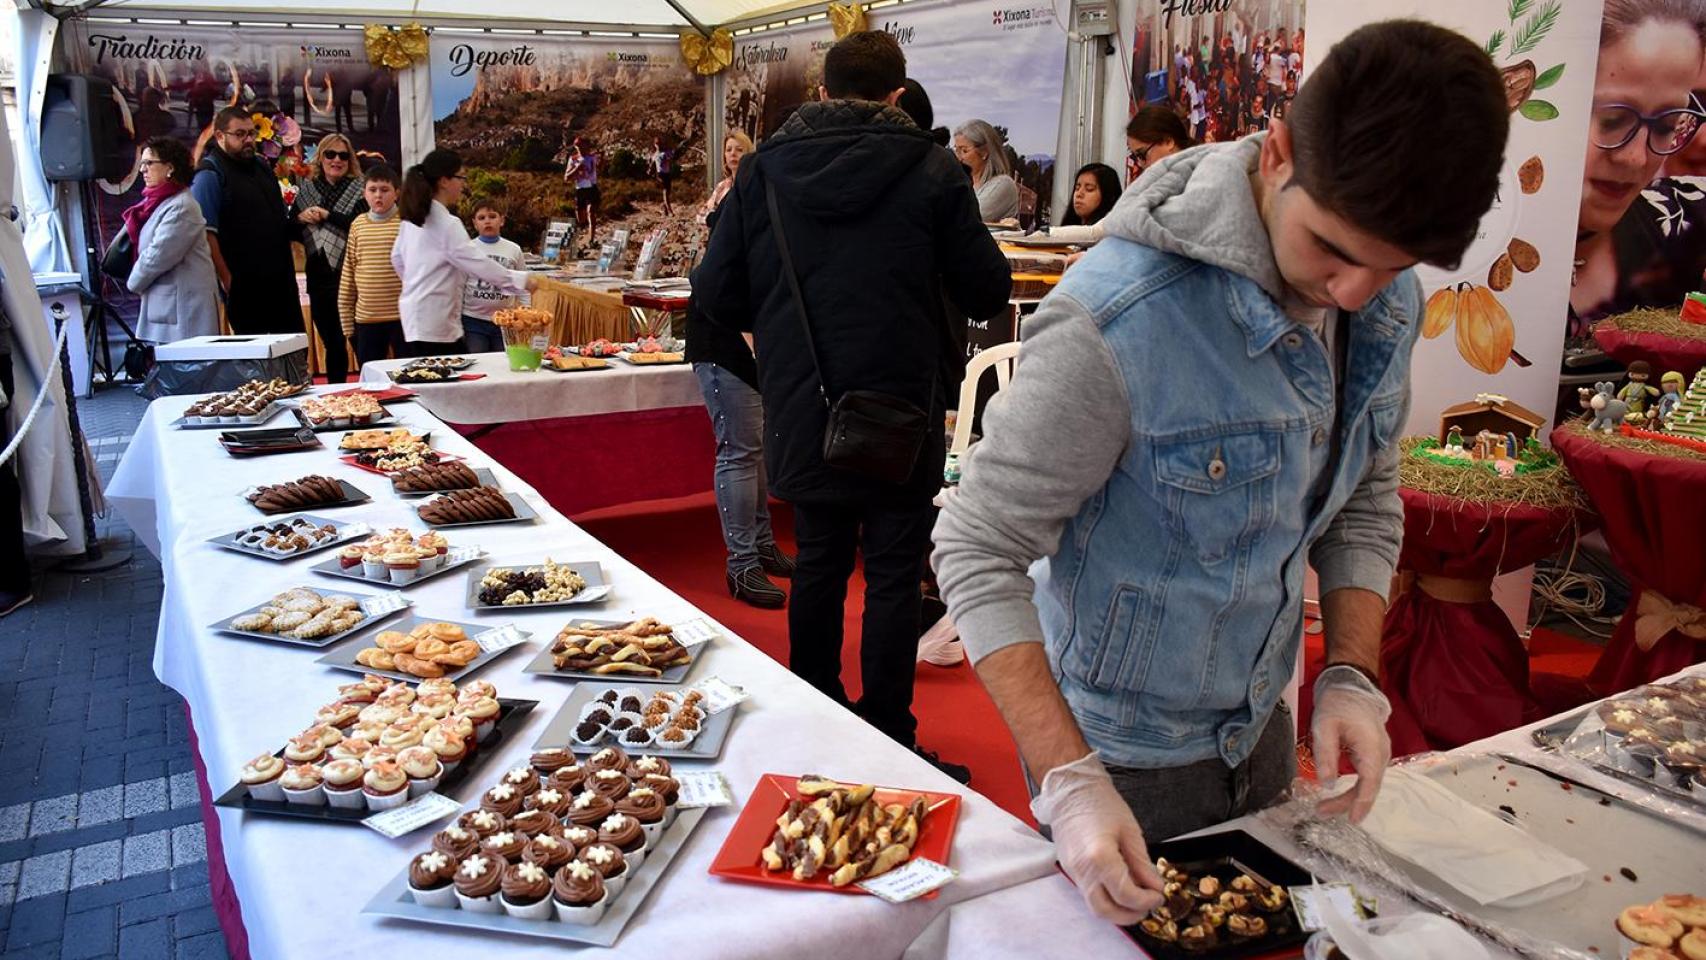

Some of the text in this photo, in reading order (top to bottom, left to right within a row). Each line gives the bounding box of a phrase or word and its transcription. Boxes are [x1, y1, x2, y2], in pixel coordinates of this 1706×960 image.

[1003, 9, 1030, 22] Xixona
[88, 34, 205, 64] Tradición
[315, 46, 351, 57] Xixona
[618, 53, 647, 62] Xixona
[735, 41, 788, 71] Naturaleza
[449, 44, 536, 77] Deporte
